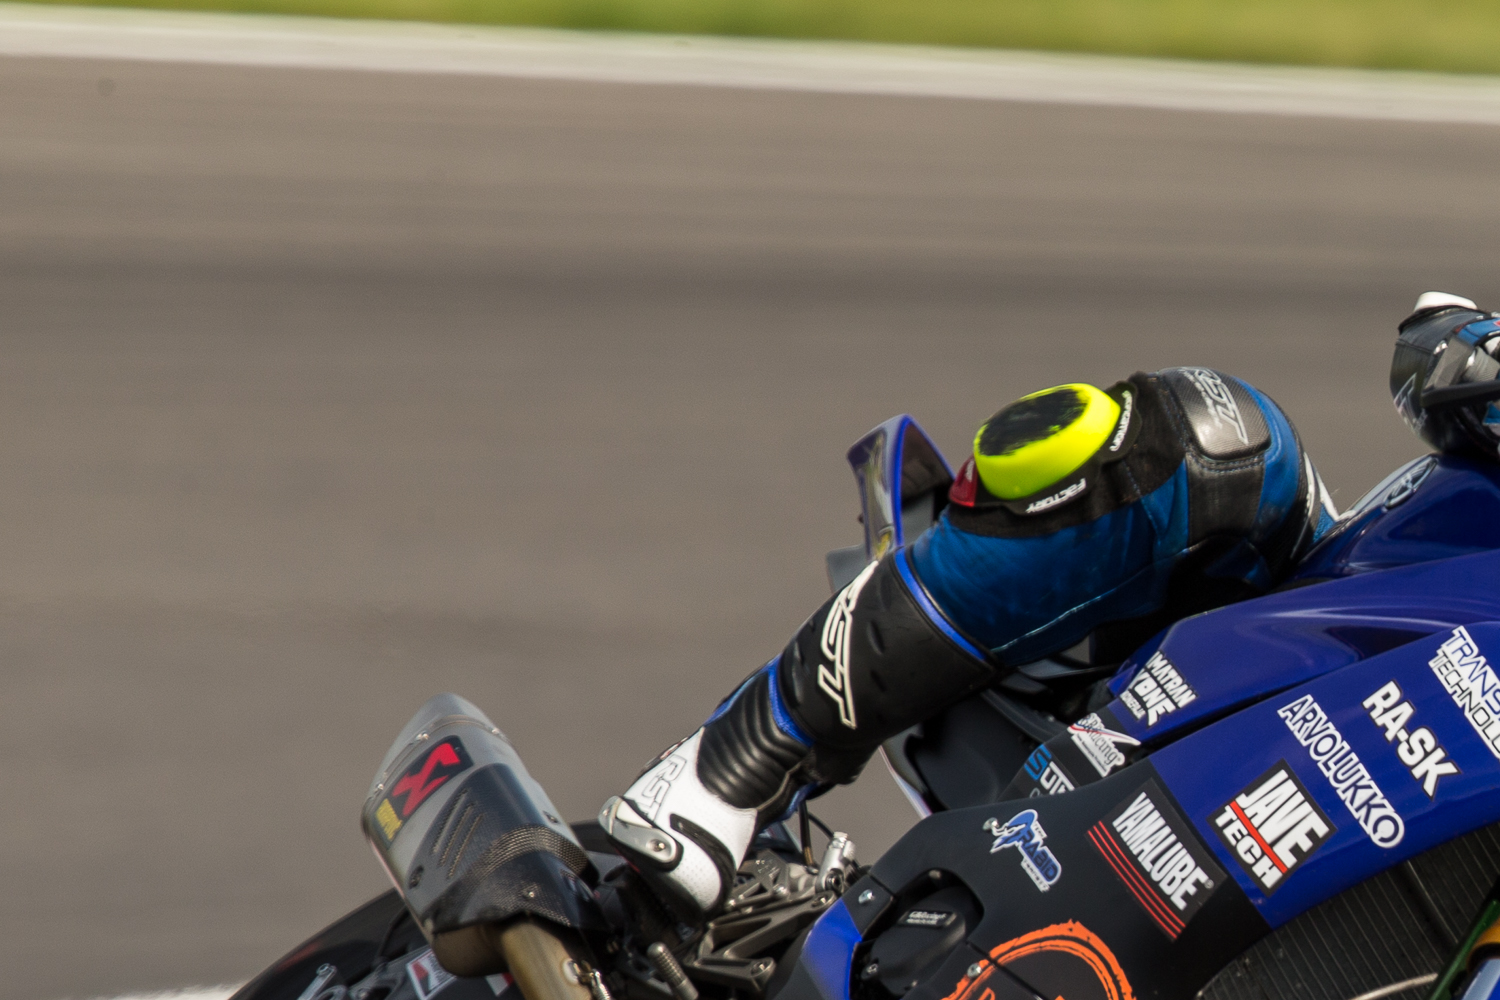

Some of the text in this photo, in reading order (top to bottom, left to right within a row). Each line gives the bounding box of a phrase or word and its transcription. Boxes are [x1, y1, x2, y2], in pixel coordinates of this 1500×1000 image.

[818, 560, 879, 729] RST
[1279, 696, 1403, 848] ARVOLUKKO
[1362, 681, 1460, 797] RA-SK
[1112, 790, 1206, 908] YAMALUBE
[1215, 806, 1288, 889] TECH
[1235, 768, 1329, 868] JAVE
